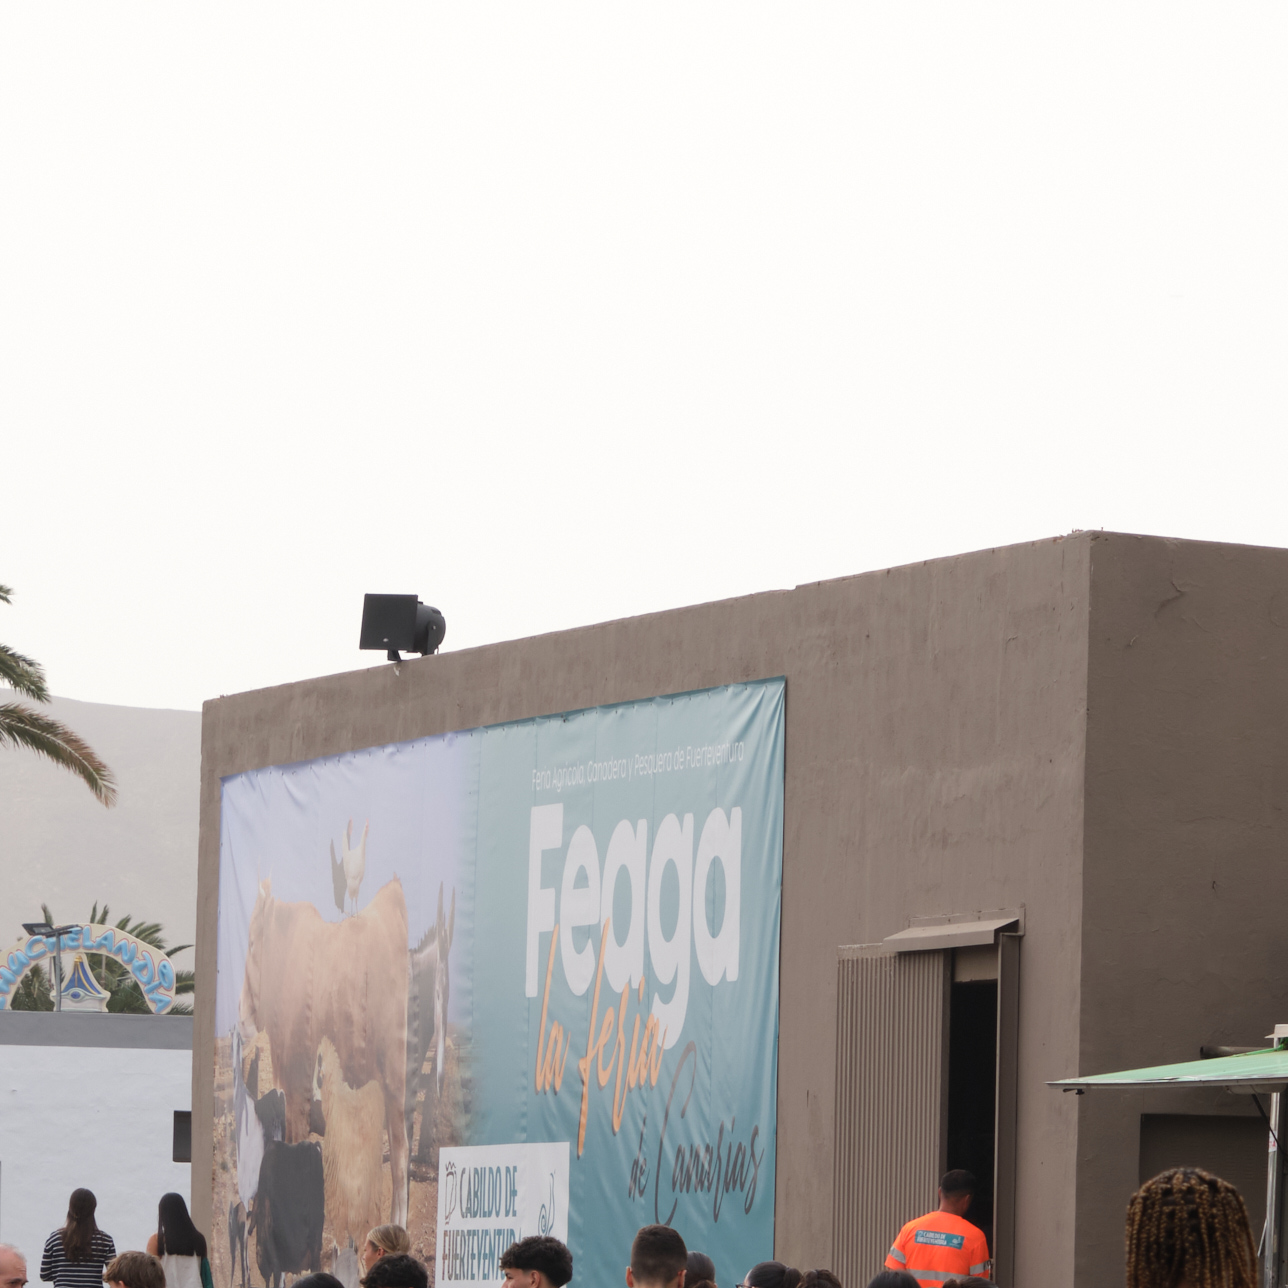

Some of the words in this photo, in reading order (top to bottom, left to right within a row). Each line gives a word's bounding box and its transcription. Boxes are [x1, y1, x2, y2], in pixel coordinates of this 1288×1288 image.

[531, 766, 551, 791] Feria
[587, 756, 627, 782] Ganadera
[628, 757, 634, 781] y
[634, 752, 672, 779] Pesquera
[673, 746, 685, 770] de
[686, 741, 745, 769] Fuerteventura
[525, 803, 742, 1050] Feaga
[535, 924, 571, 1095] la
[577, 917, 668, 1160] feria
[459, 1167, 502, 1219] CABILDO
[505, 1165, 518, 1218] DE
[629, 1116, 650, 1202] de
[655, 1041, 764, 1227] Canarias
[442, 1227, 522, 1281] FUERTEVENTU
